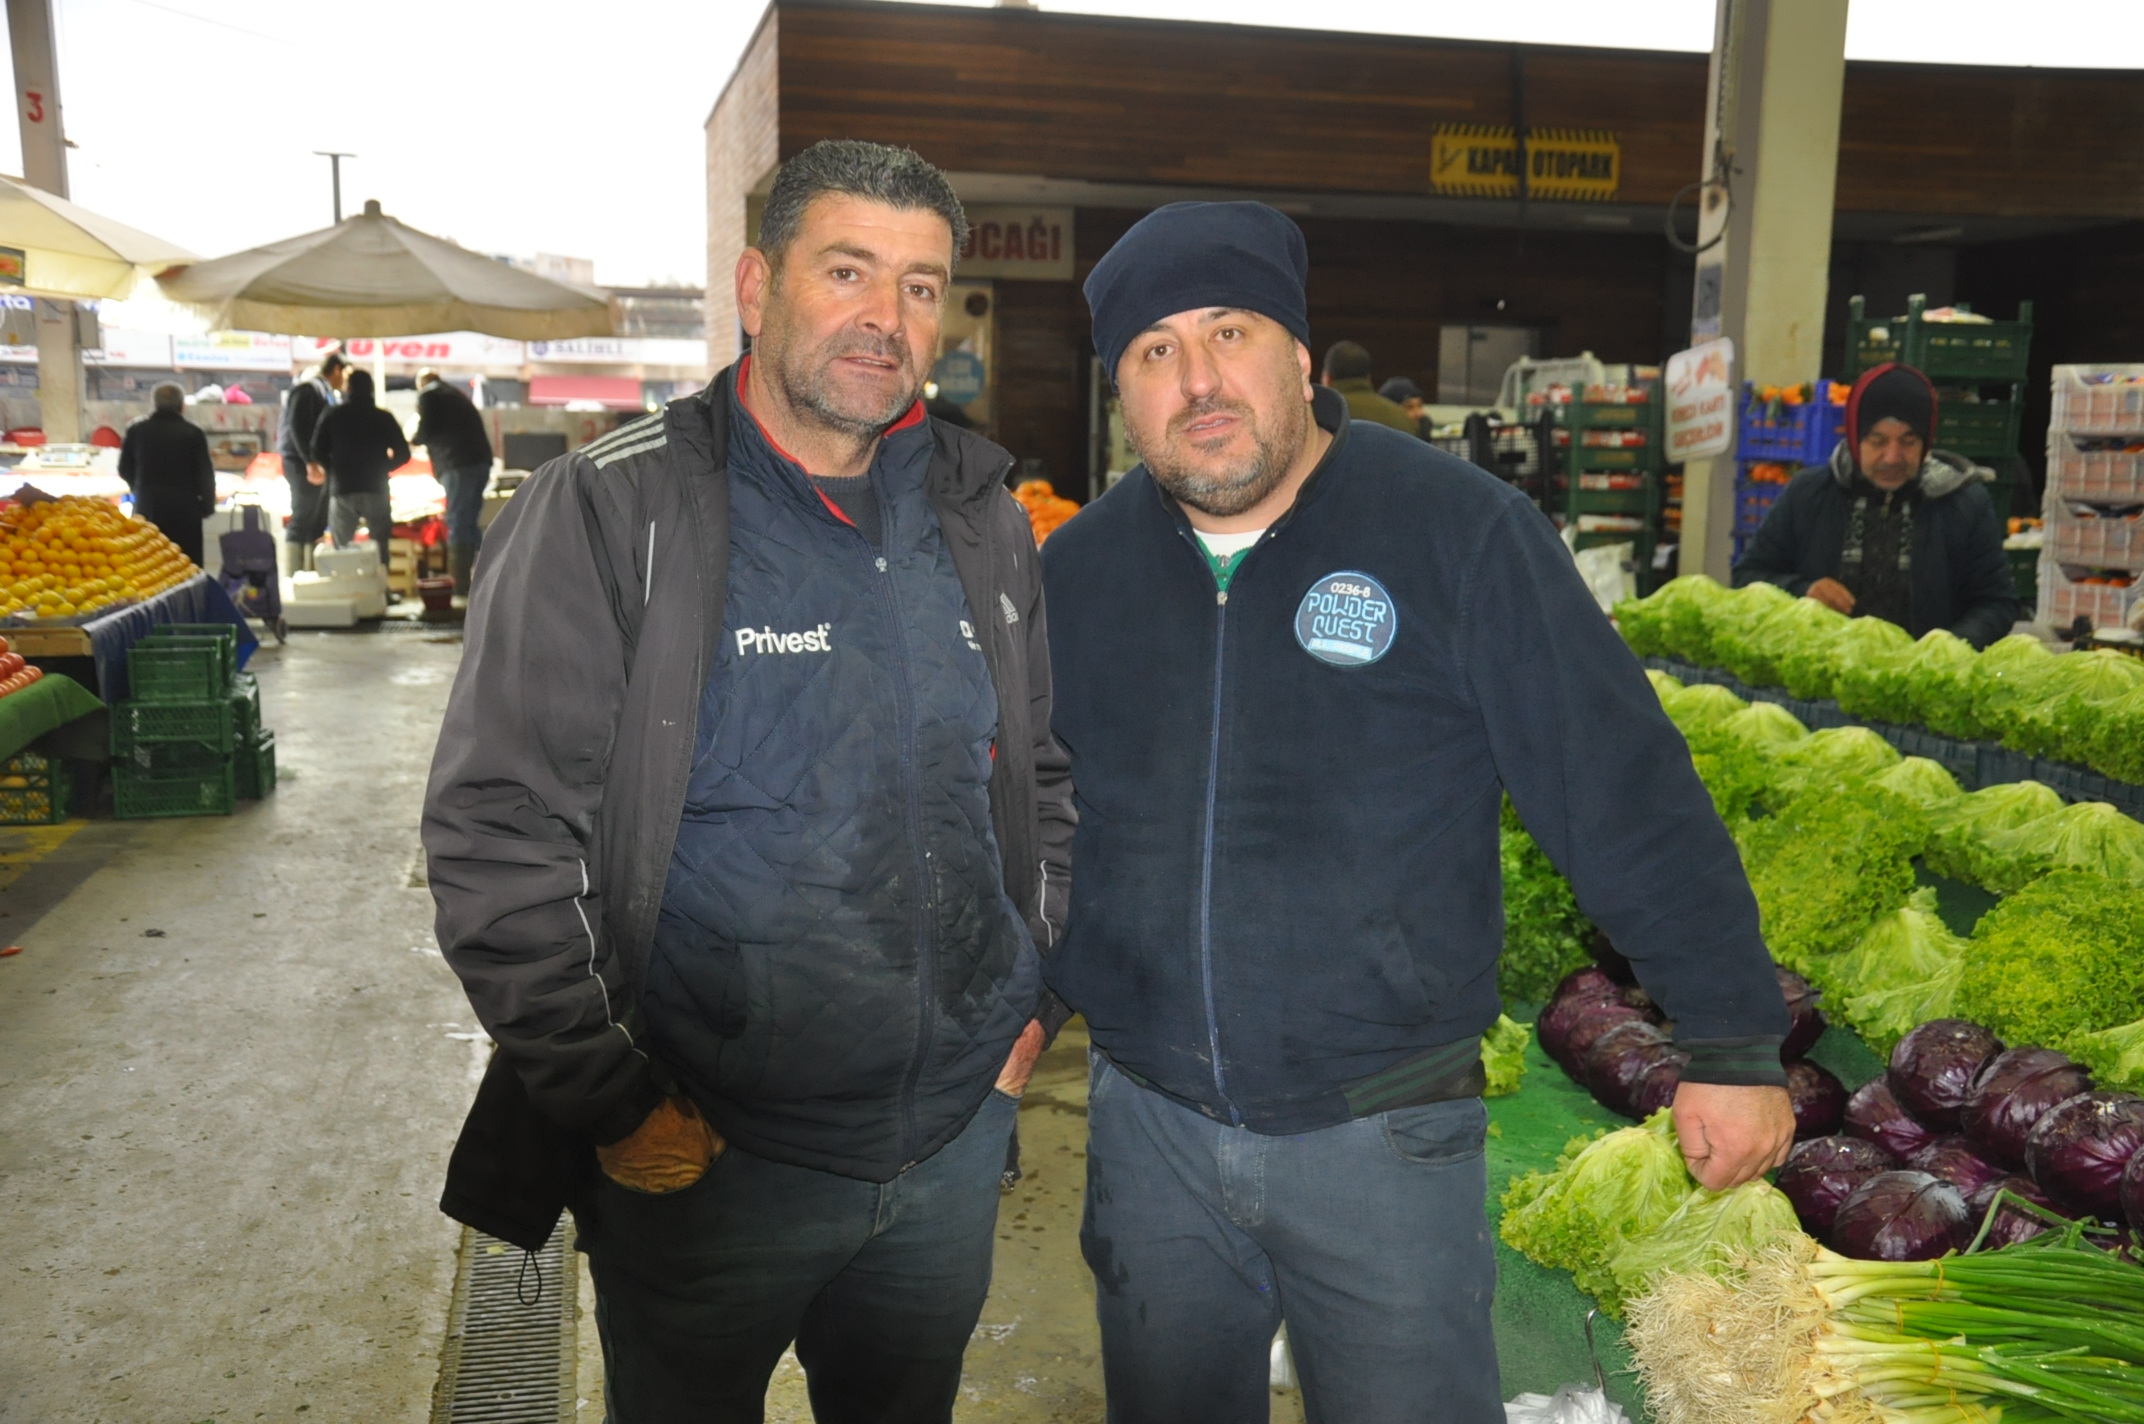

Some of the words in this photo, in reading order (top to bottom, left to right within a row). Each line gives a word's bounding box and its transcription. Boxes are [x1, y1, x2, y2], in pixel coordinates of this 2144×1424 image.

[25, 91, 44, 124] 3
[1533, 151, 1613, 179] OTOPARK
[1331, 582, 1371, 597] 0236-8
[1308, 593, 1387, 623] POWDER
[1312, 615, 1377, 643] QUEST
